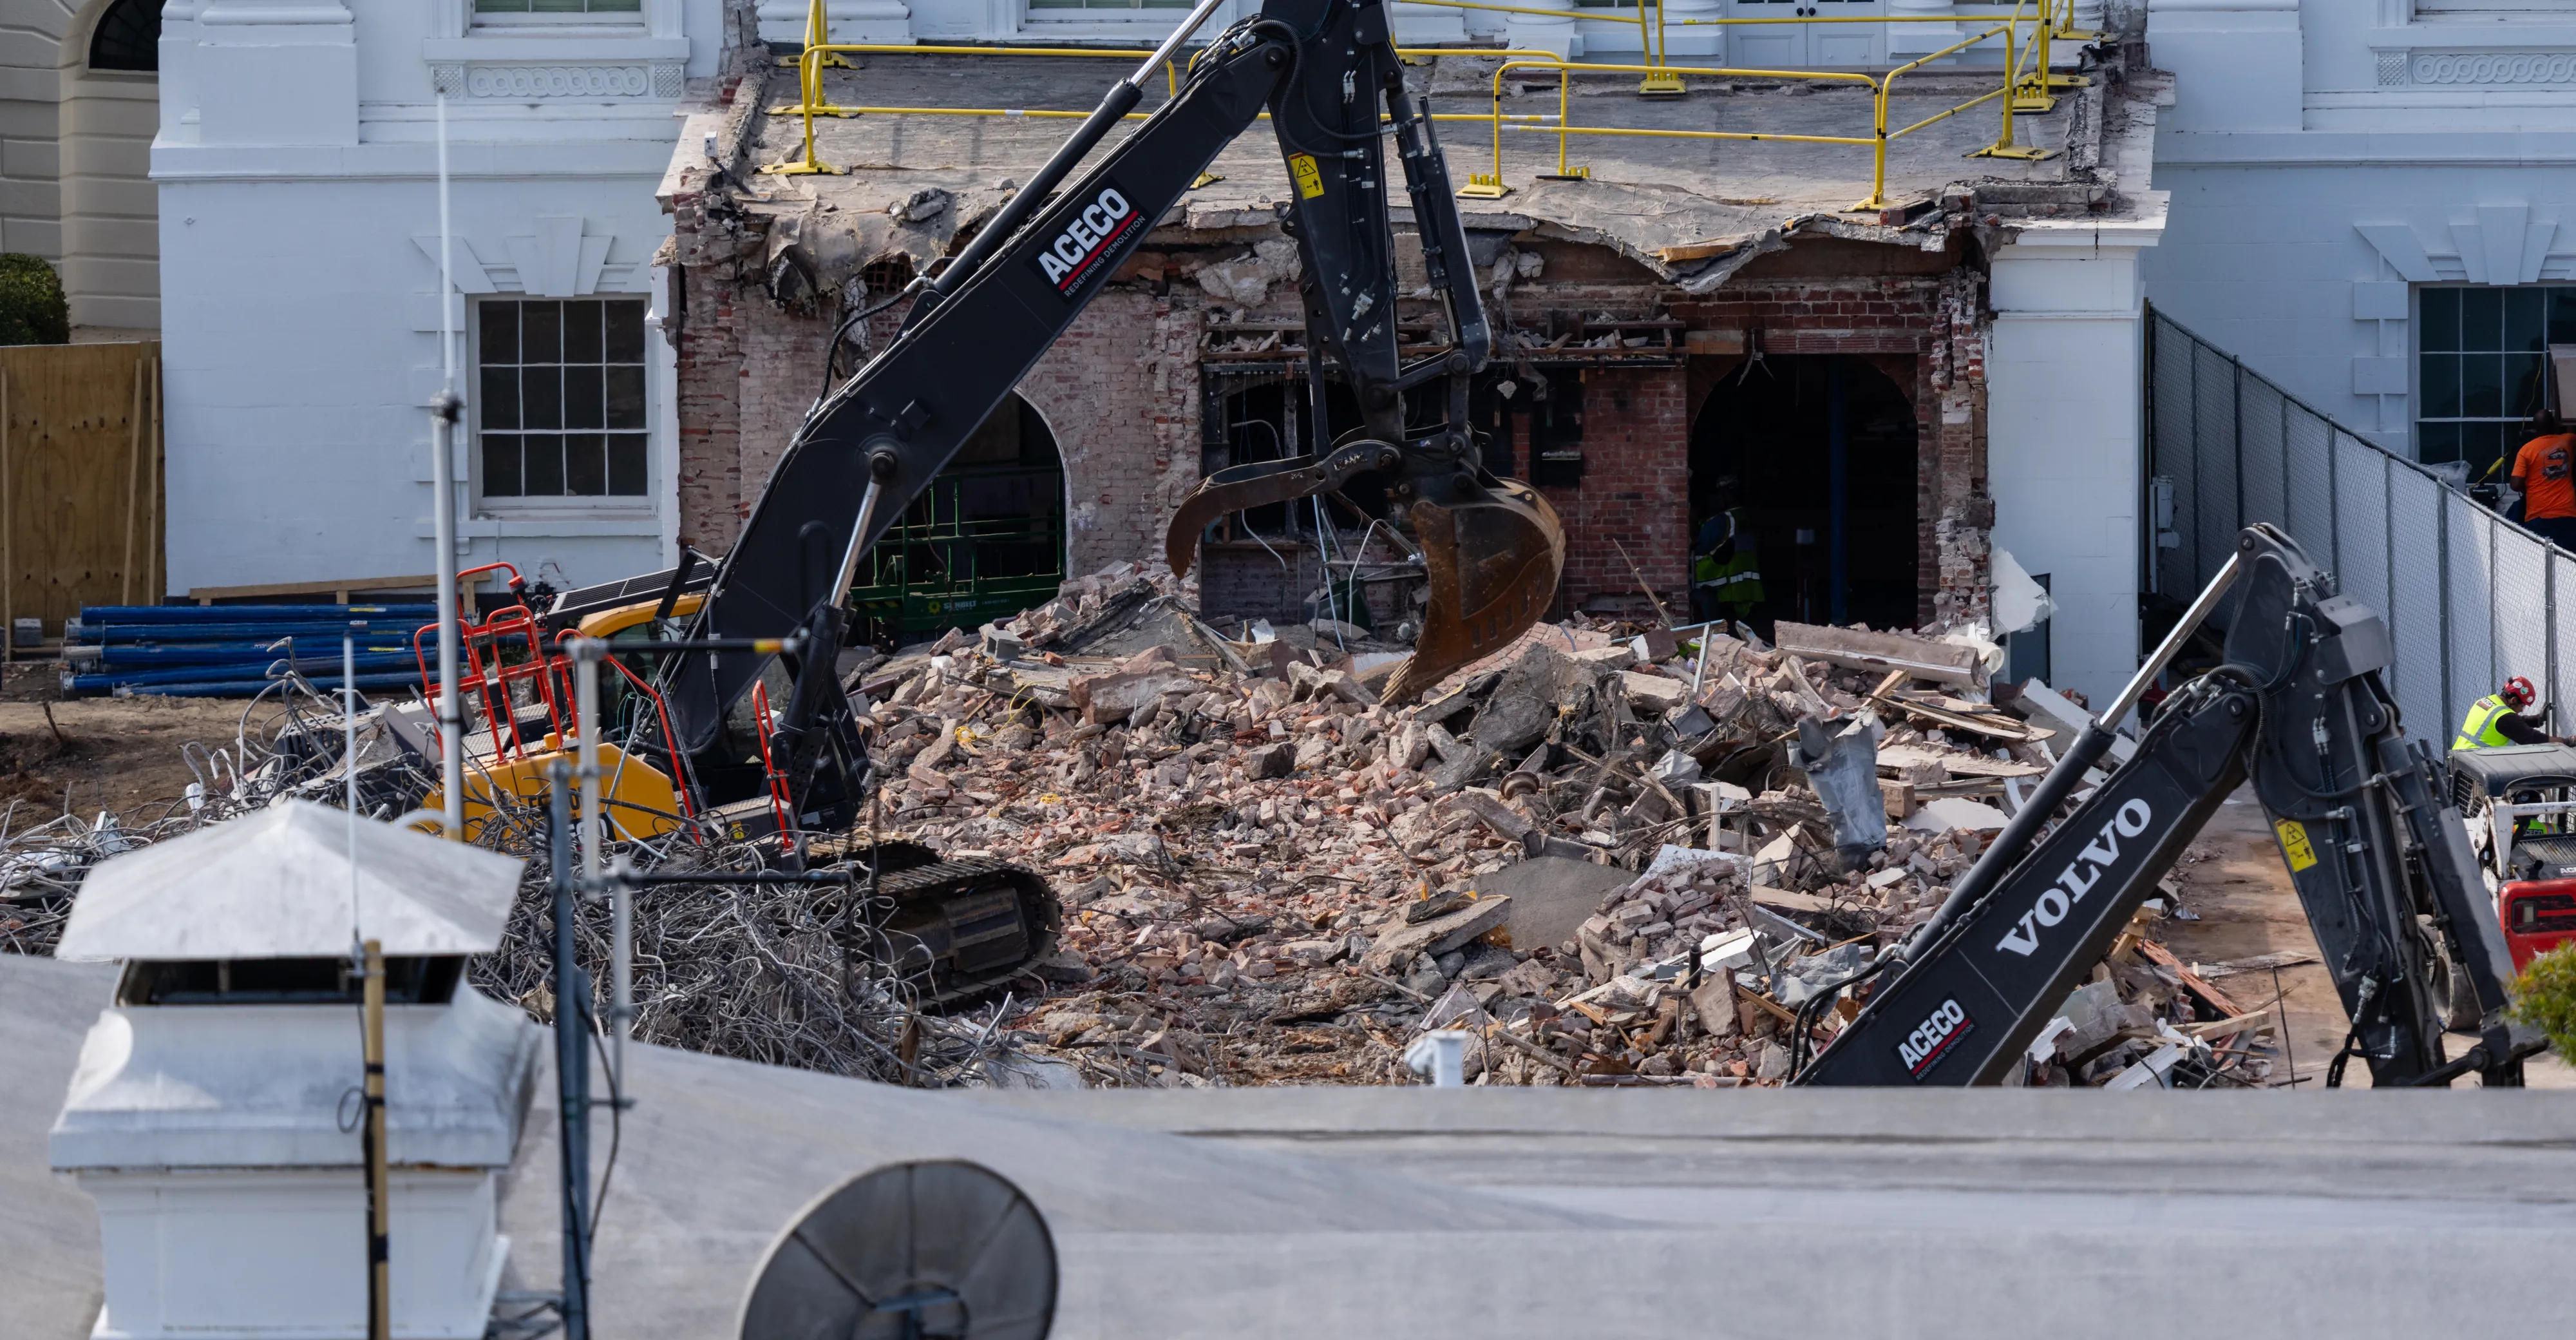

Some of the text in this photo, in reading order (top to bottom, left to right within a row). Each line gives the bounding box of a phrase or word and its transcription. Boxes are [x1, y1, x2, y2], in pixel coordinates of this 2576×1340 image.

[1038, 188, 1130, 285] ACECO
[1064, 216, 1146, 297] REDEFINING DEMOLITION
[1994, 798, 2151, 957] VOLVO
[1898, 999, 1964, 1071] ACECO
[1916, 1023, 1975, 1080] REDEFINING DEMOLITION
